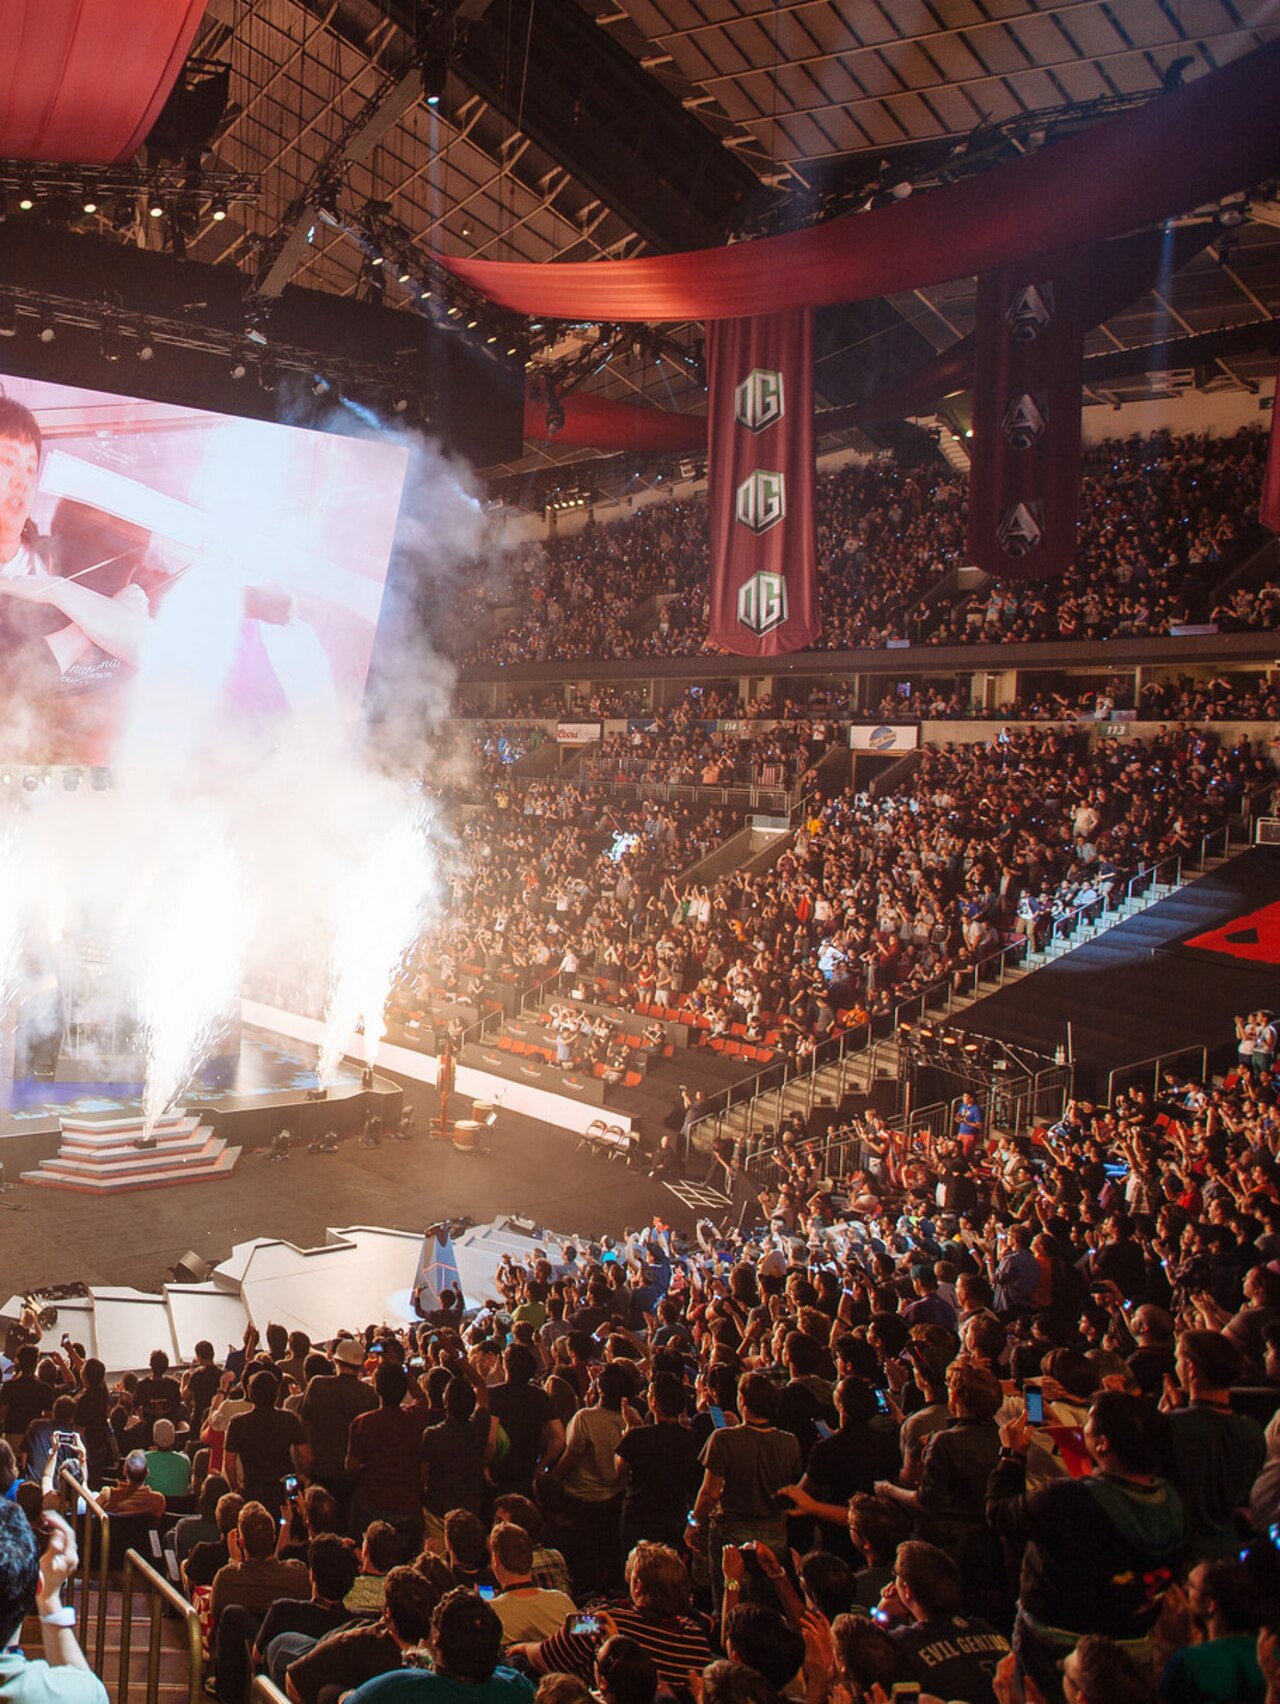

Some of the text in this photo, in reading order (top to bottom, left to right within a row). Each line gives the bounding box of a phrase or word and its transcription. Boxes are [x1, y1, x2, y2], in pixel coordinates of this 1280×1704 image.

[734, 370, 784, 432] OG
[736, 470, 785, 534] OG
[738, 571, 787, 636] OG
[1107, 725, 1126, 735] 113
[919, 1640, 960, 1667] EVIL
